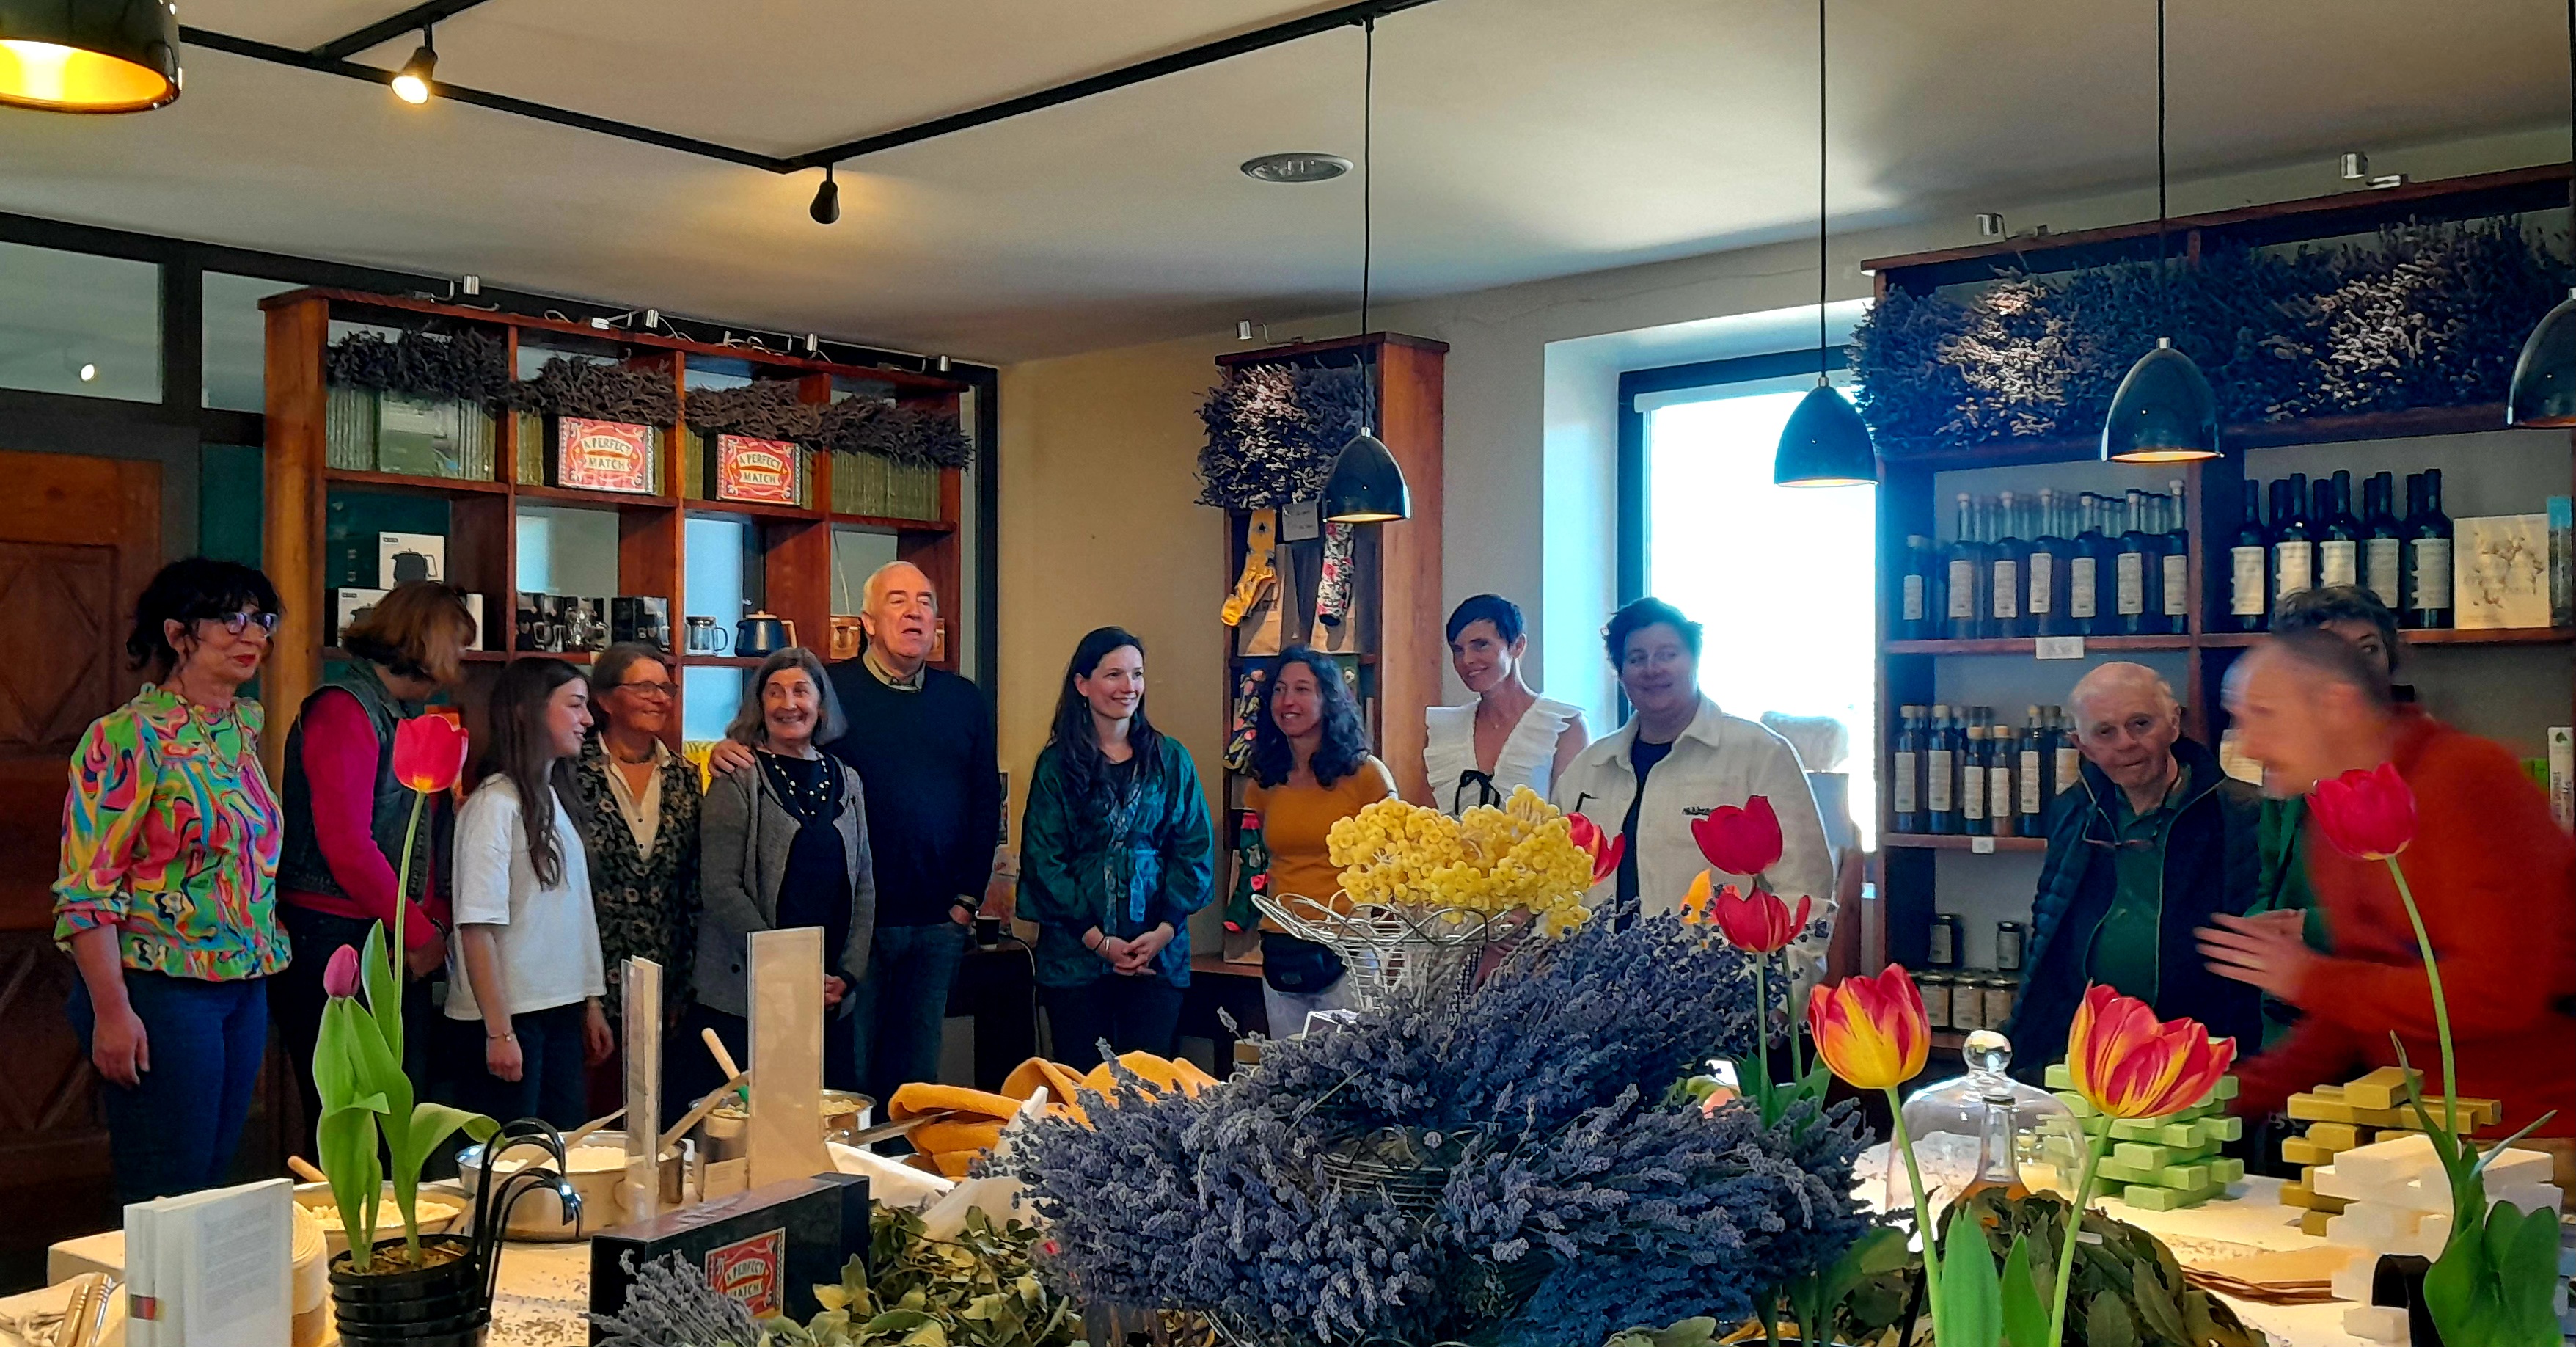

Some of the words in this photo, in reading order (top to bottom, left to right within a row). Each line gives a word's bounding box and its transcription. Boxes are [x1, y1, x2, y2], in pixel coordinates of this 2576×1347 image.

[583, 440, 590, 450] A
[592, 438, 632, 453] PERFECT
[589, 457, 625, 470] MATCH
[740, 456, 746, 464] A
[747, 453, 781, 469] PERFECT
[744, 472, 775, 484] MATCH
[727, 1273, 732, 1282] A
[733, 1260, 764, 1278] PERFECT
